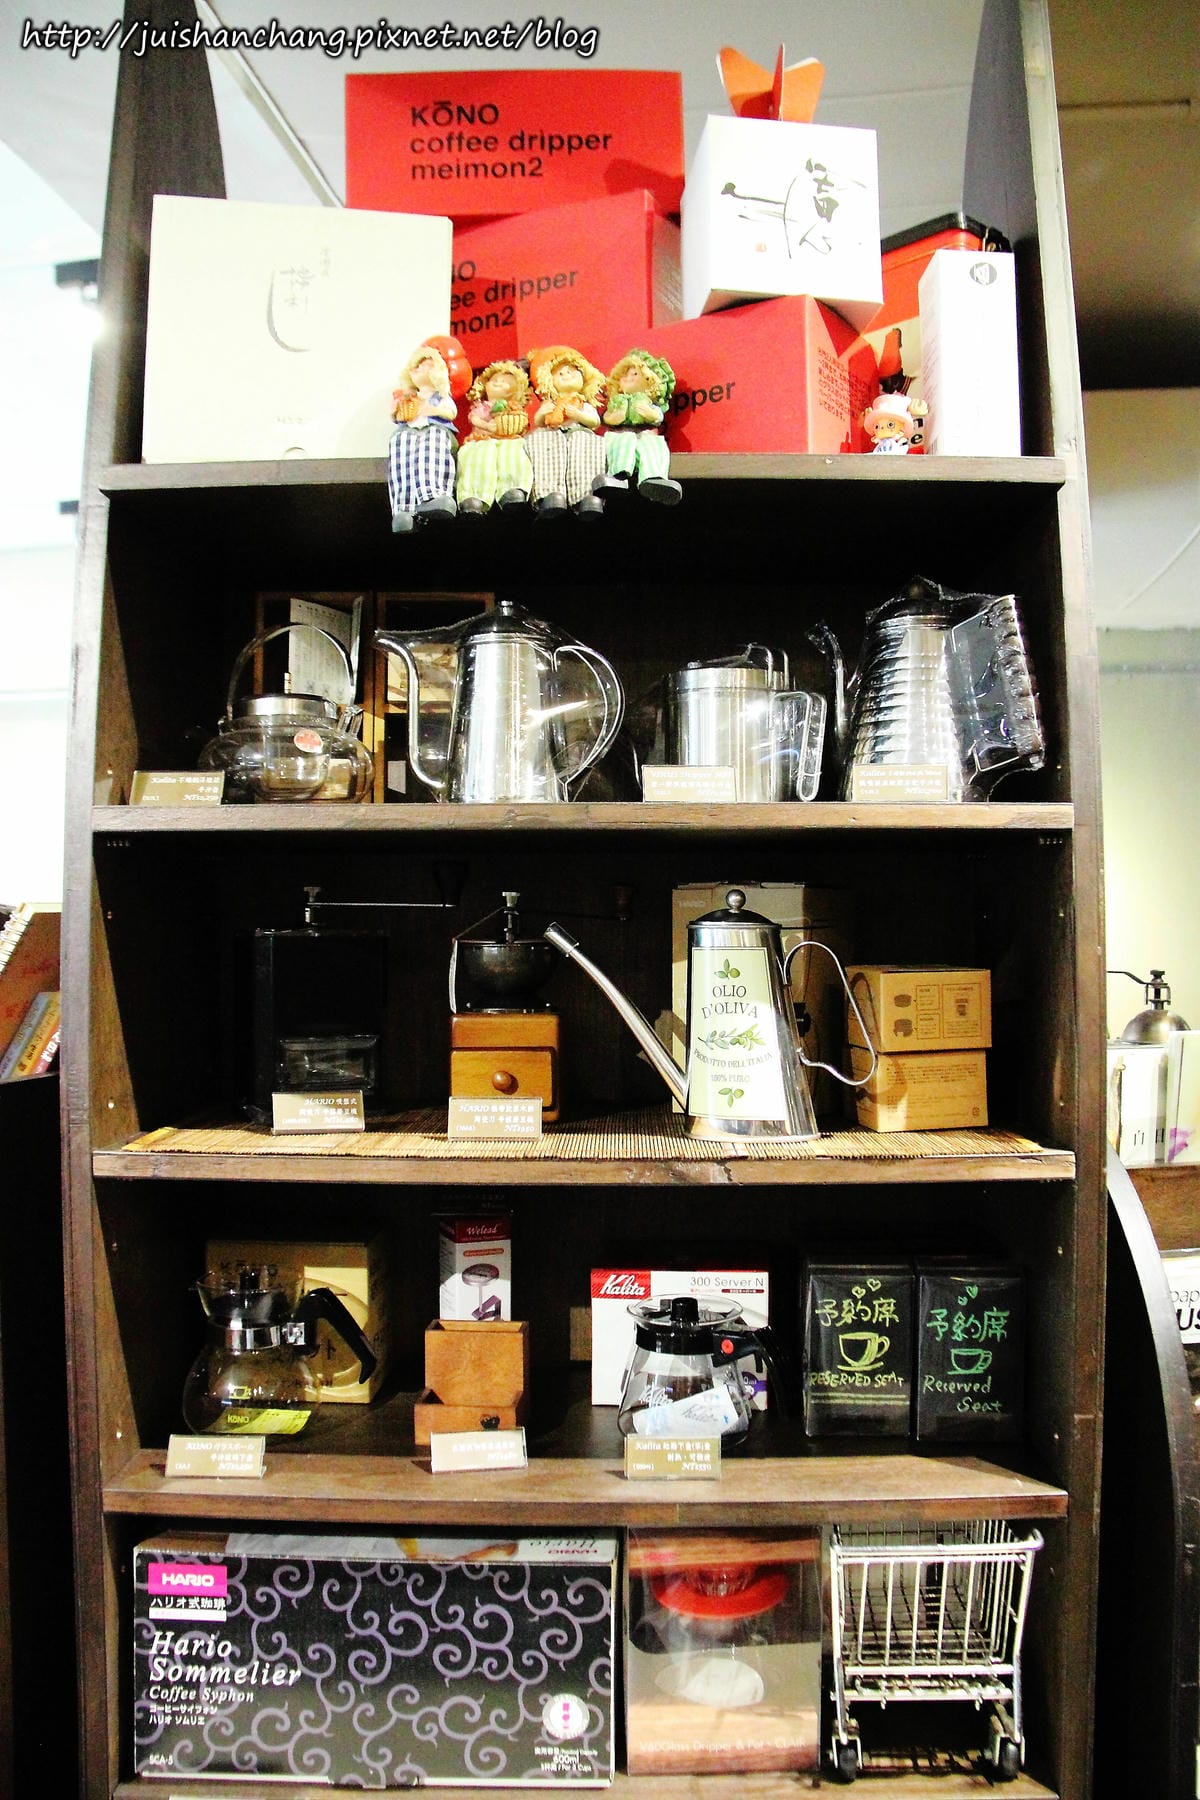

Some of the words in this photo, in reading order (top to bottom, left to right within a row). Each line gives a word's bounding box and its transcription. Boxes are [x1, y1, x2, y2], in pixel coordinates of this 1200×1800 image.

[410, 132, 499, 153] coffee
[508, 130, 612, 155] dripper
[411, 157, 543, 179] meimon2
[484, 270, 578, 302] dripper
[712, 985, 747, 998] OLIO
[701, 1002, 758, 1019] D'OLIVA
[694, 1048, 726, 1068] PRODOTTO
[600, 1274, 646, 1296] Kalita
[690, 1276, 711, 1286] 300
[714, 1276, 751, 1287] Server
[755, 1277, 764, 1287] N
[809, 1370, 871, 1388] RESERVED
[875, 1371, 904, 1388] SEAT
[923, 1375, 992, 1394] Reserved
[957, 1397, 1002, 1413] Seat
[161, 1573, 215, 1587] HARIO
[150, 1631, 232, 1658] Hario
[150, 1656, 302, 1687] Sommelier
[150, 1685, 197, 1703] Coffee
[201, 1687, 255, 1703] Syphon
[553, 1753, 579, 1764] 600ml
